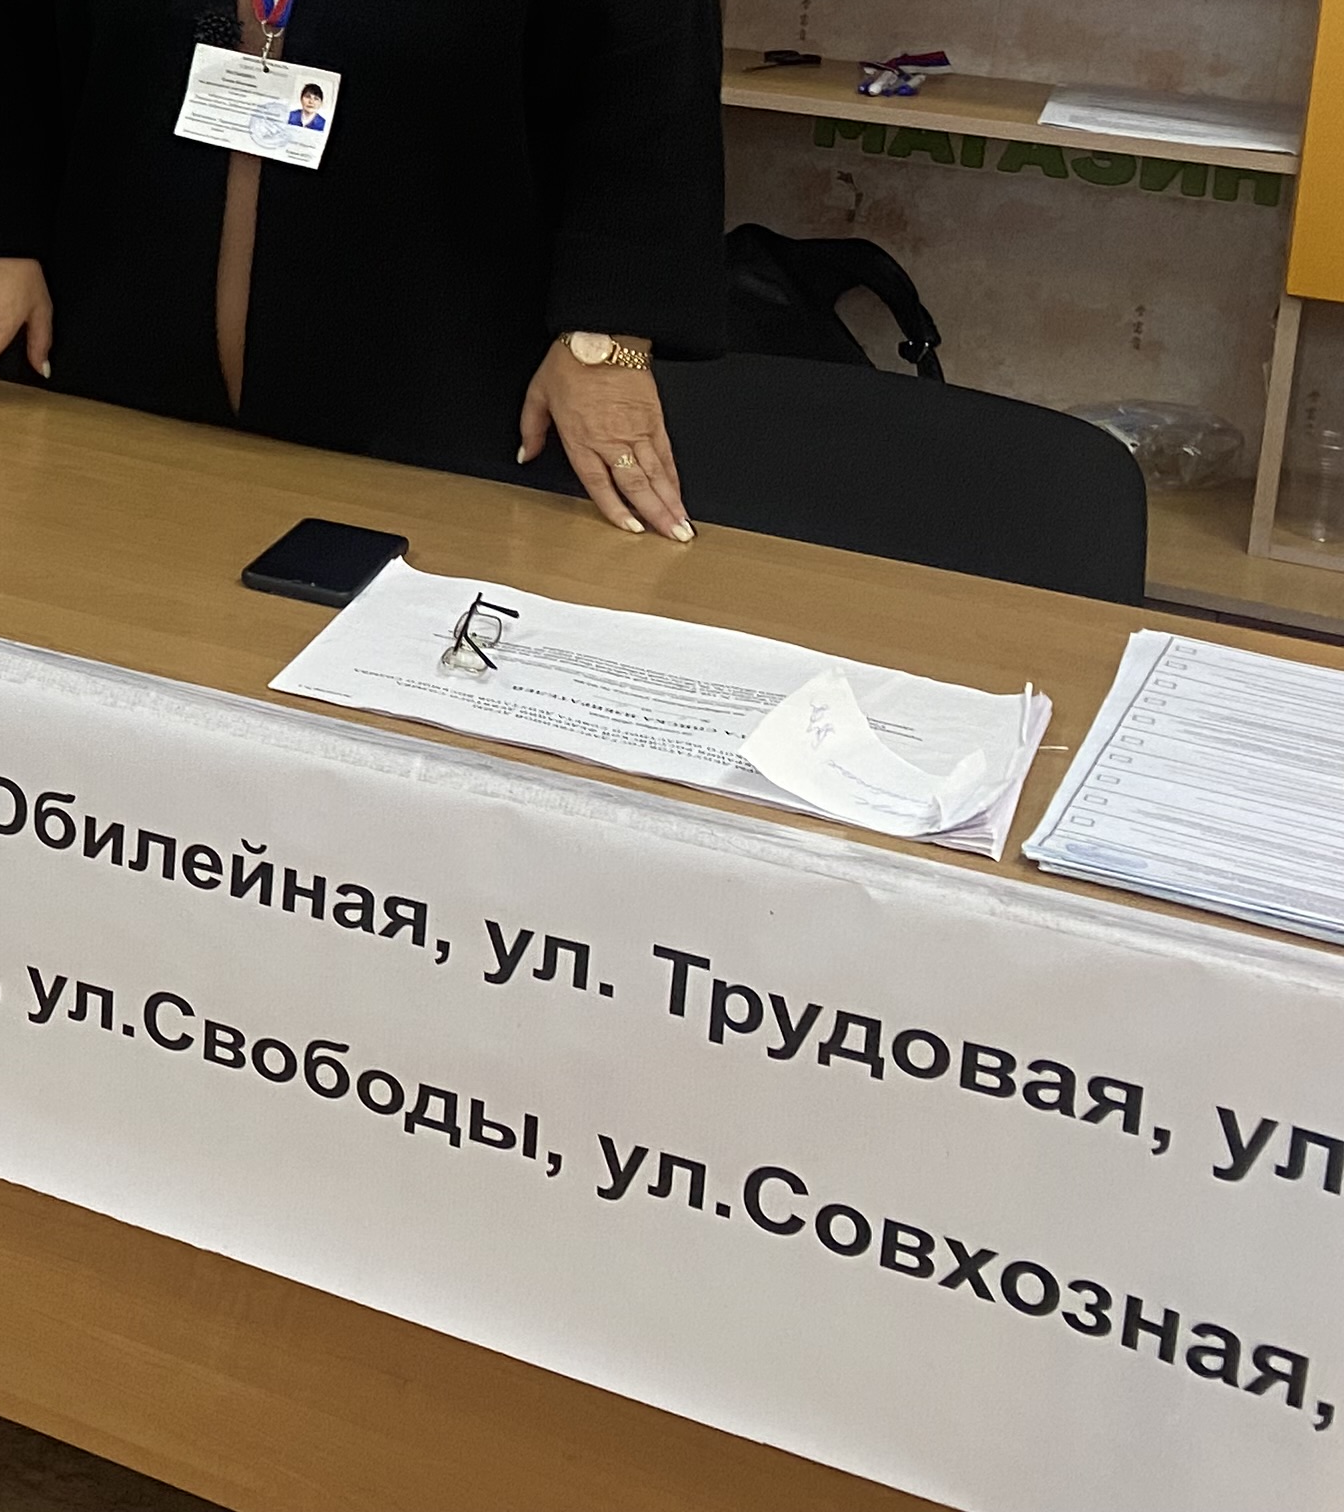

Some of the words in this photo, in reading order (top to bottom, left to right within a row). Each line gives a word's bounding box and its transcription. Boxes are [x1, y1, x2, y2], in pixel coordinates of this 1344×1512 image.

[26, 965, 563, 1179] ул.Свободы,
[596, 1133, 1336, 1431] ул.Совхозная,
[482, 918, 615, 999] ул.
[652, 944, 1172, 1156] Трудовая,
